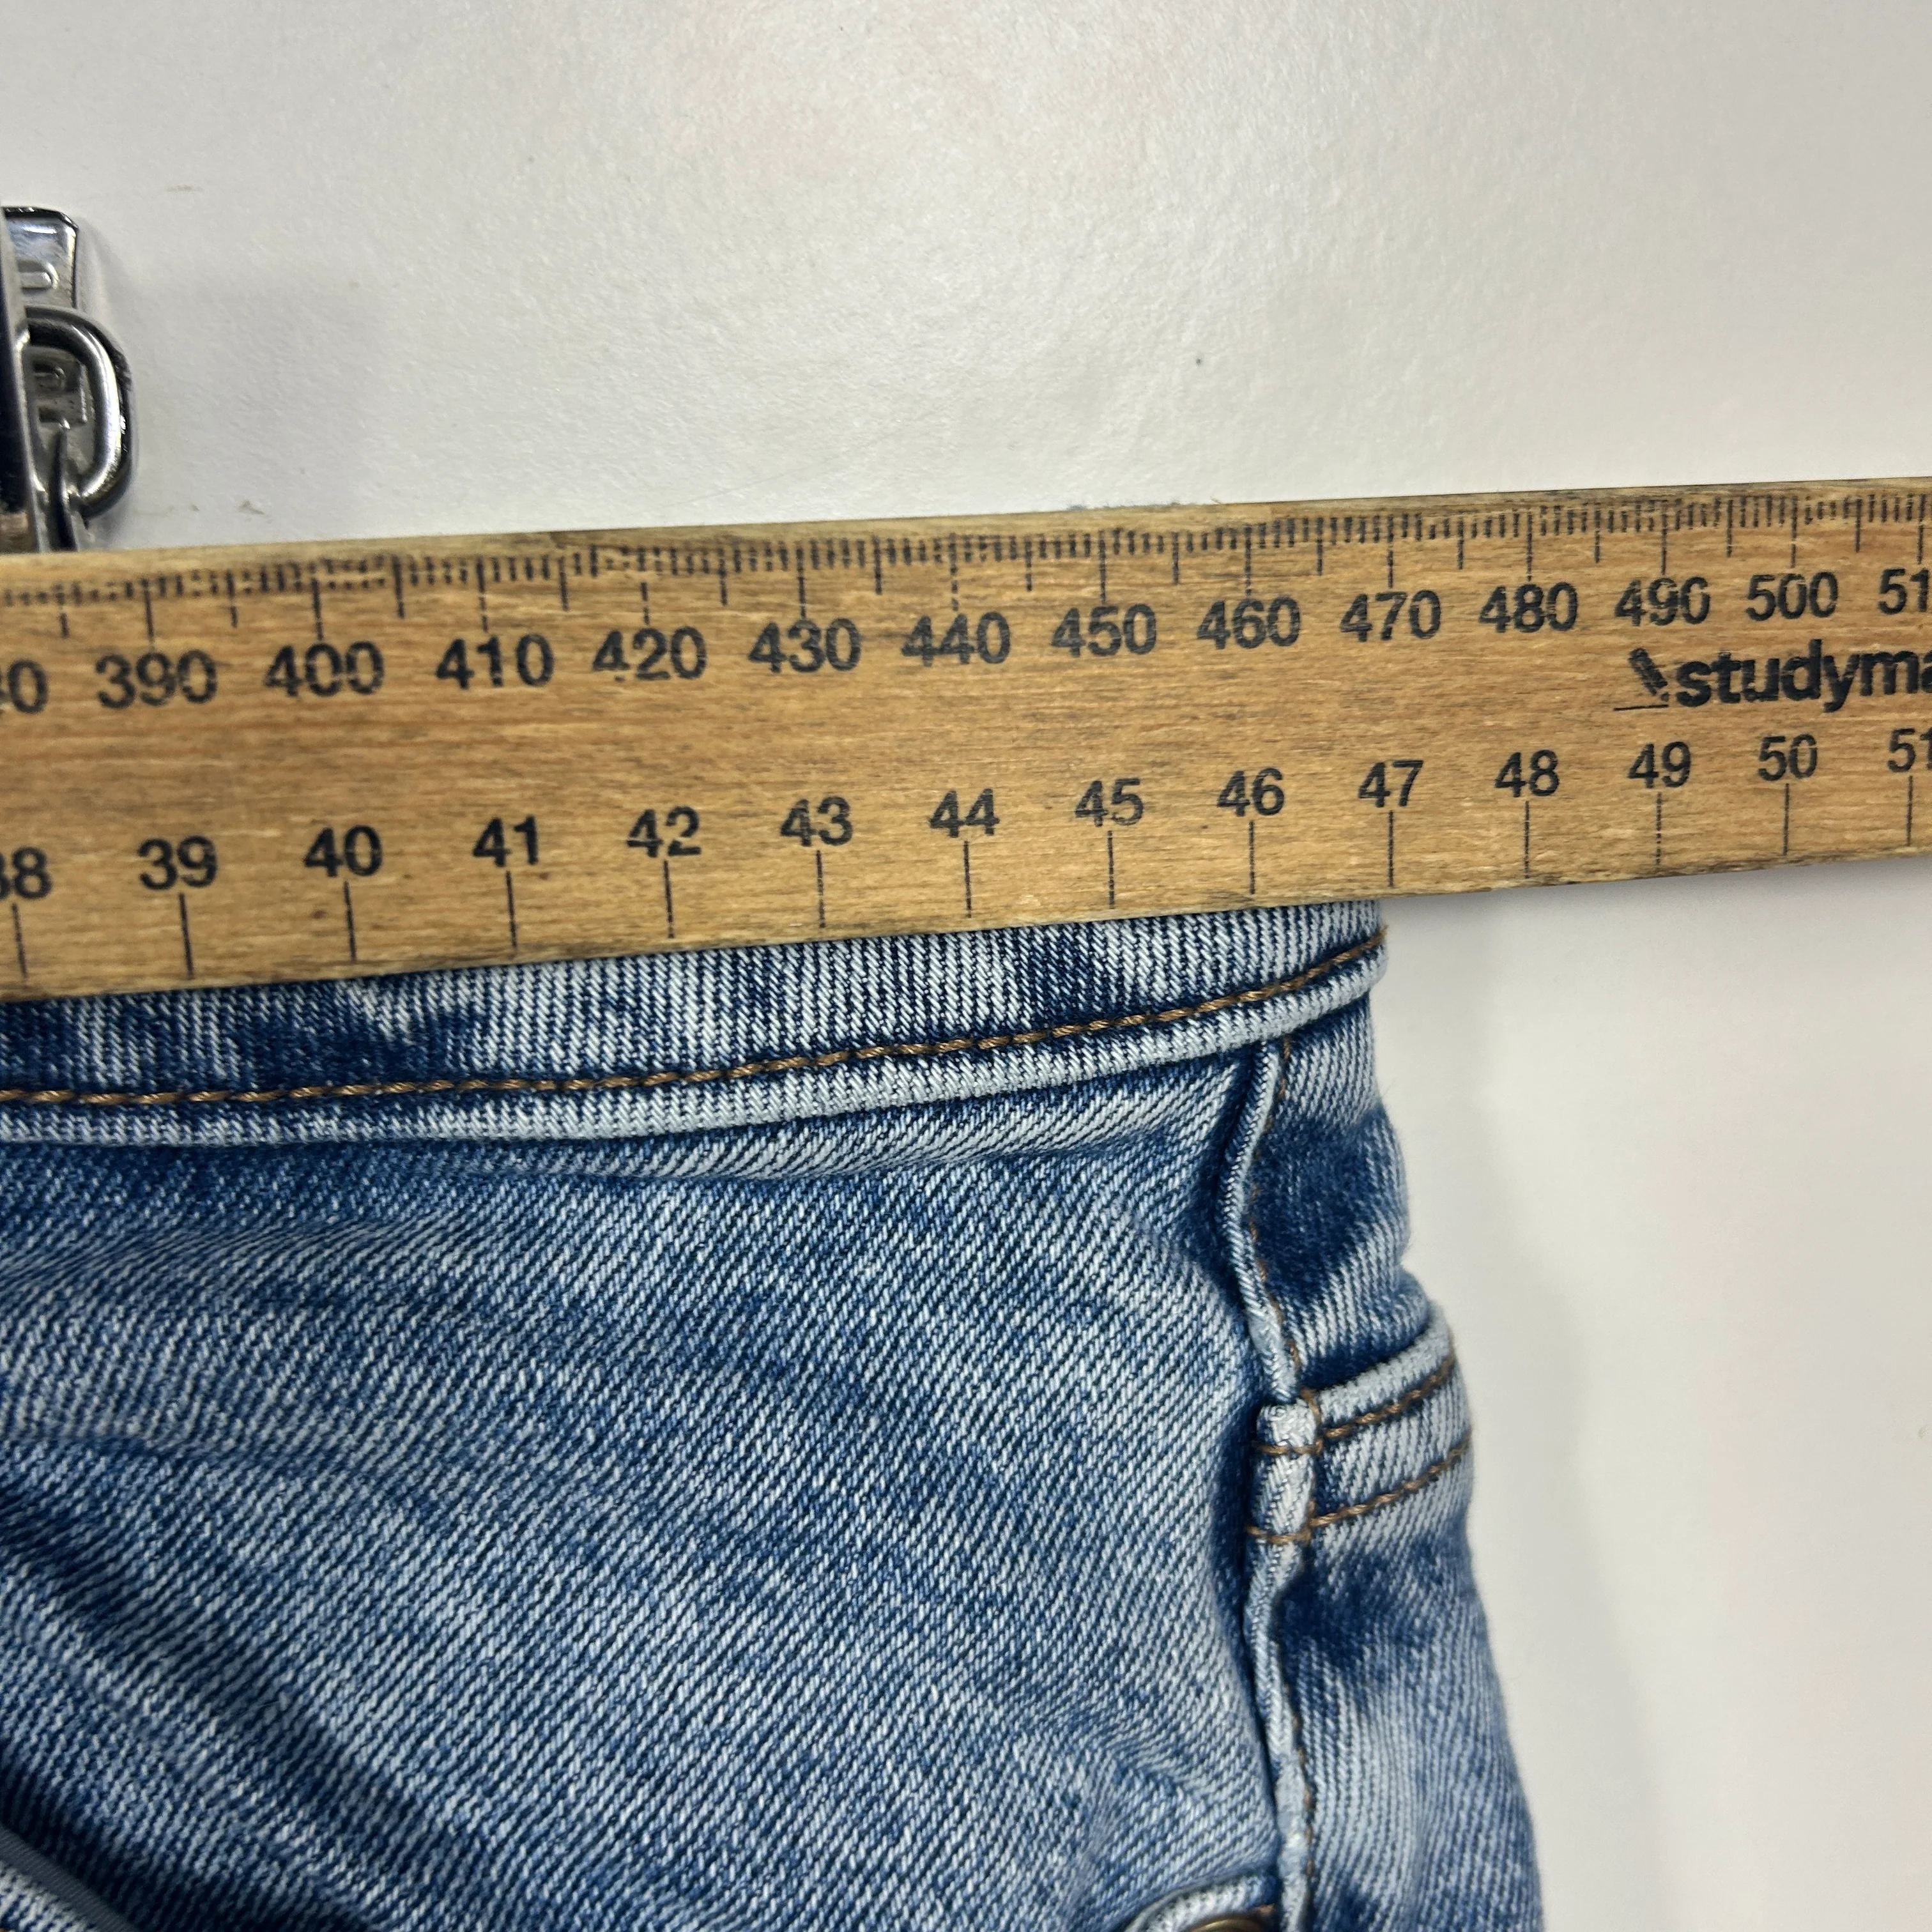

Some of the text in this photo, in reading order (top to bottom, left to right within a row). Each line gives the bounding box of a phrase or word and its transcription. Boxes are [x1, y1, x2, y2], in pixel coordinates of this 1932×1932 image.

[0, 659, 49, 714] 0
[96, 649, 218, 709] 390
[264, 641, 383, 697] 400
[436, 634, 555, 688] 410
[592, 625, 707, 683] 420
[747, 618, 861, 674] 430
[901, 612, 1011, 667] 440
[1051, 604, 1157, 657] 450
[1196, 597, 1301, 650] 460
[1341, 590, 1441, 642] 470
[1479, 582, 1578, 634] 480
[1614, 576, 1710, 626] 490
[1745, 571, 1838, 622] 500
[0, 845, 53, 900] 8
[137, 834, 218, 891] 39
[303, 824, 383, 877] 40
[473, 815, 539, 868] 41
[627, 806, 702, 858] 42
[779, 797, 854, 848] 43
[929, 788, 1000, 839] 44
[1075, 777, 1144, 827] 45
[1216, 767, 1285, 817] 46
[1358, 760, 1425, 808] 47
[1494, 749, 1560, 798] 48
[1627, 741, 1692, 789] 49
[1757, 733, 1818, 781] 50
